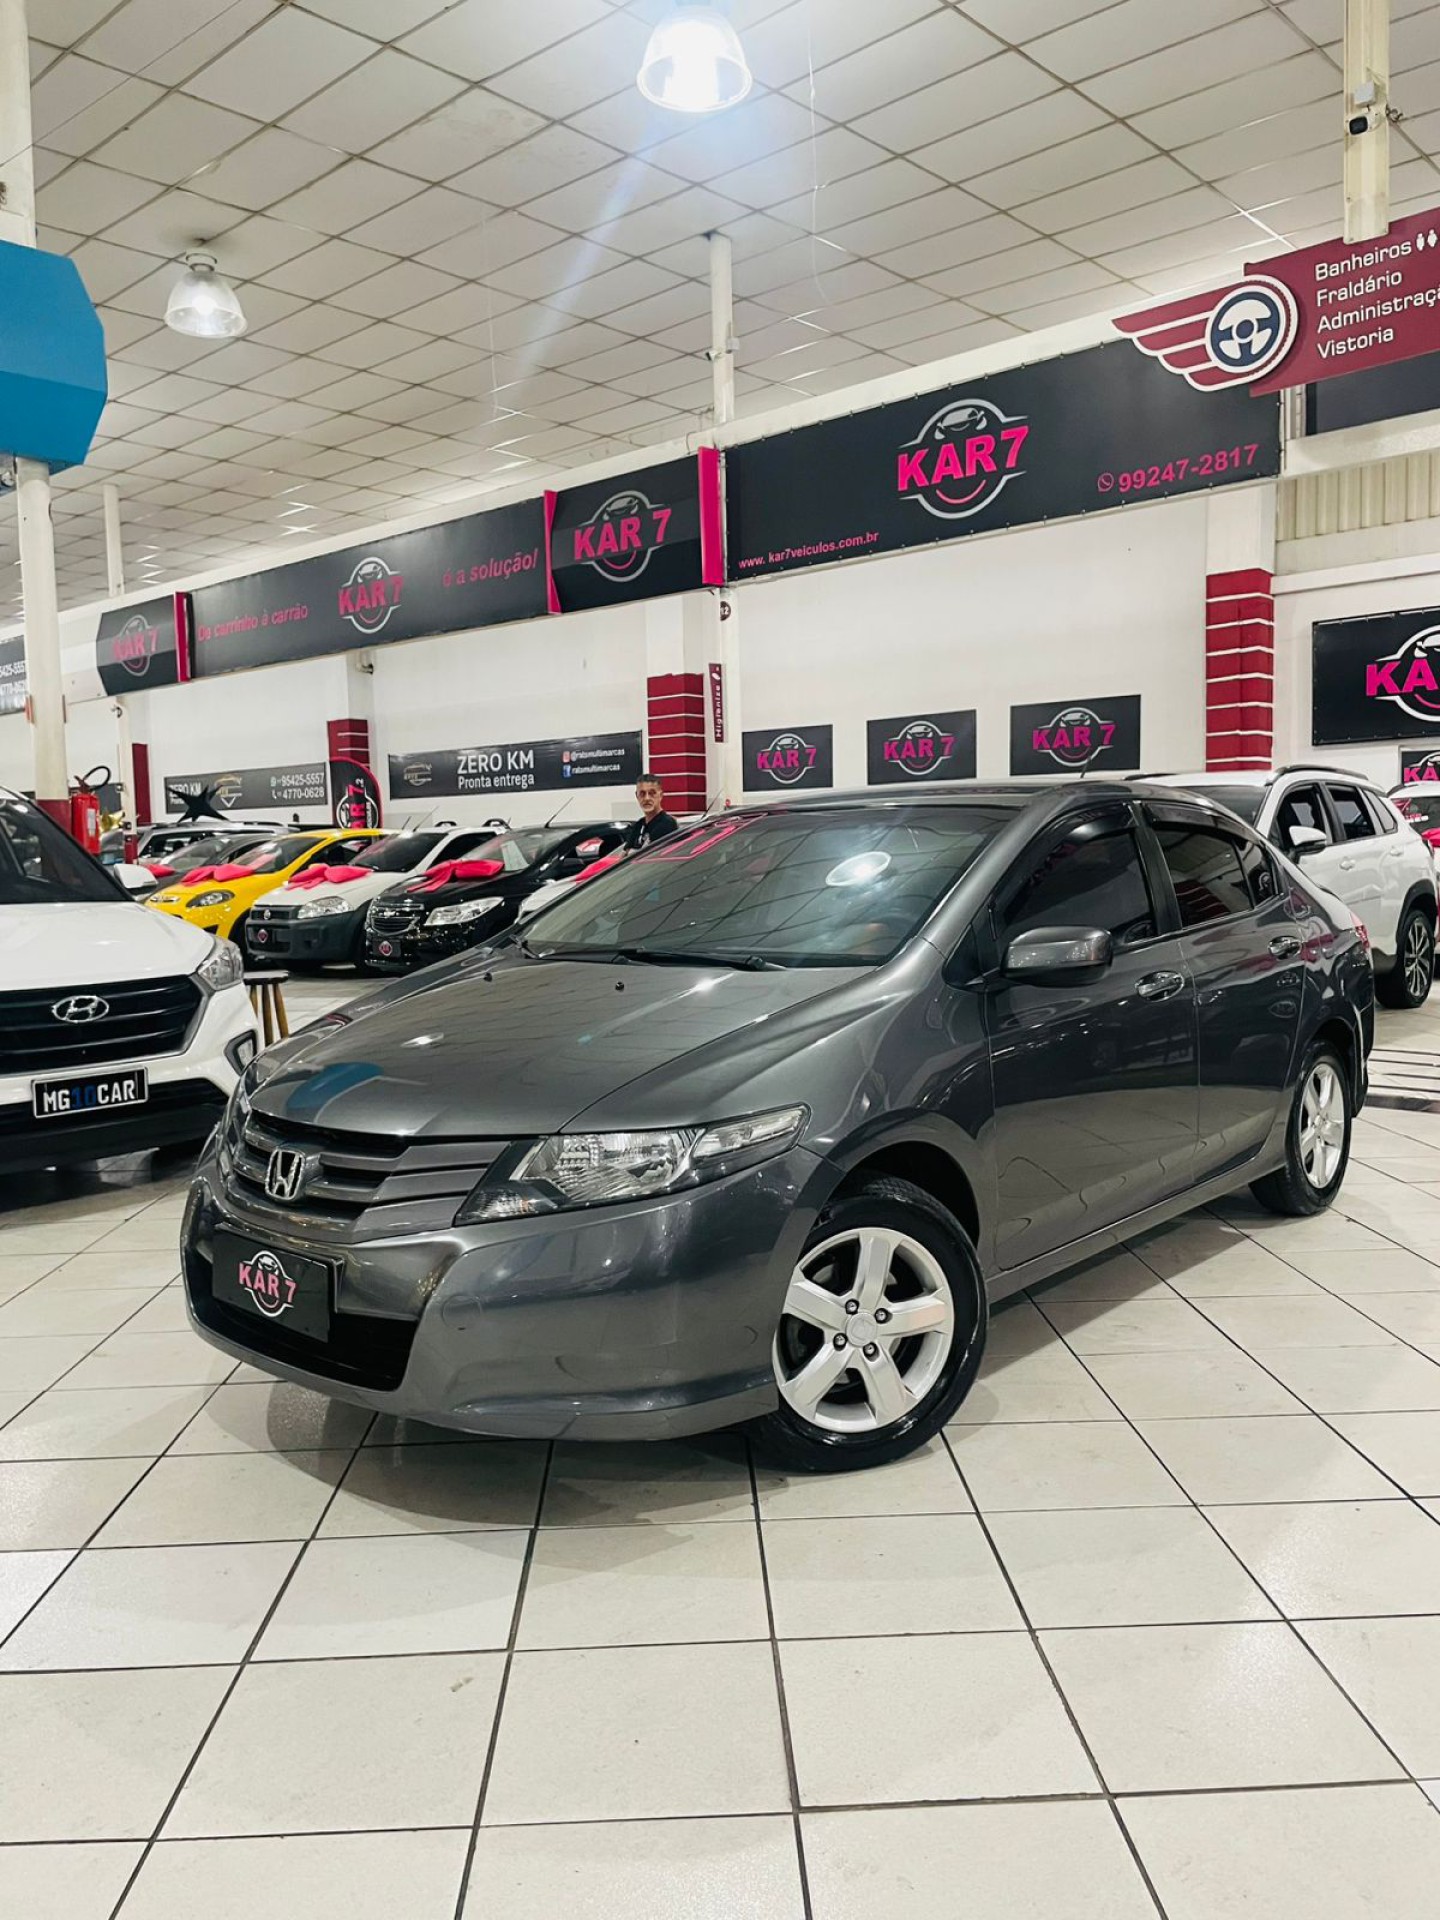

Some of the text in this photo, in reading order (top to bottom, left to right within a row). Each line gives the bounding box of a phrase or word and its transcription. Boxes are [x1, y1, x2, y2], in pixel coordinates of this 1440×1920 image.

[1315, 241, 1412, 281] Banheiros
[1317, 271, 1402, 307] Fraldário
[1317, 327, 1394, 358] Vistoria
[1119, 443, 1257, 492] 99247-2817
[470, 548, 538, 581] solução!
[457, 750, 534, 774] ZERO KM
[458, 773, 534, 789] Pronta entrega
[44, 1079, 135, 1113] MG10CAR
[239, 1262, 280, 1299] KAR
